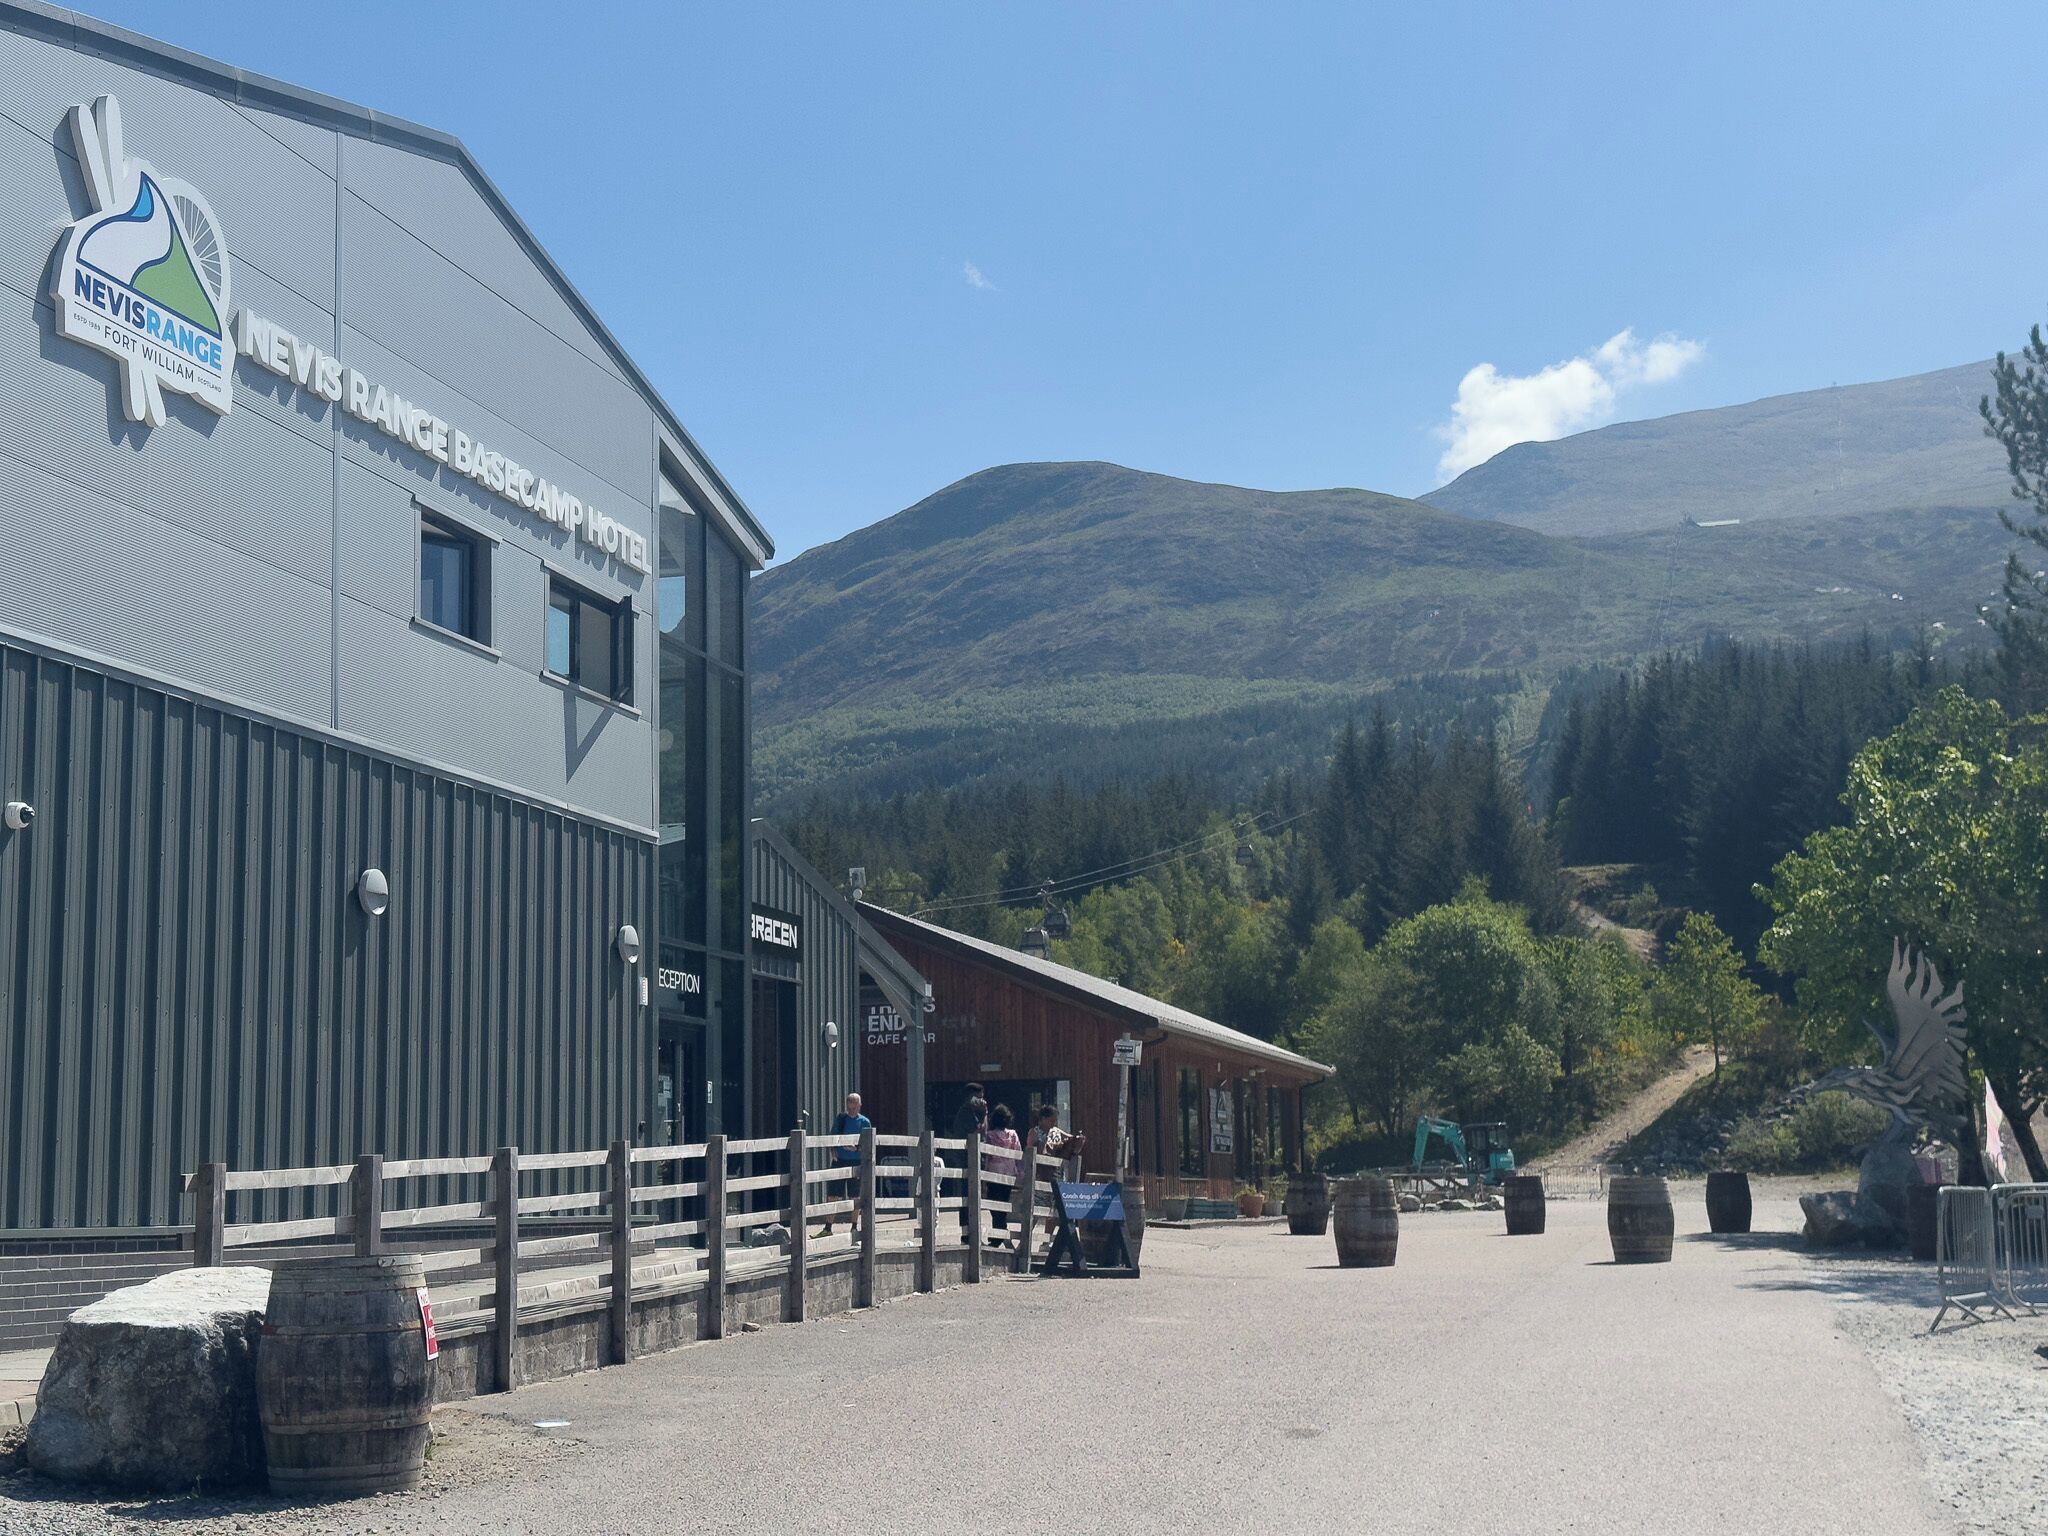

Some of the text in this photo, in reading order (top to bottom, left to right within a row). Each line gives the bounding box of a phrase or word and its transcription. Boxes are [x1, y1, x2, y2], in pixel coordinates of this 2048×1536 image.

[104, 325, 138, 353] FORT
[141, 343, 194, 383] WILLIAM
[238, 307, 653, 576] NEVIS RANGE BASECAMP HOTEL
[658, 967, 700, 994] ECEPTION
[868, 1014, 907, 1032] END
[867, 1033, 900, 1045] CAFE
